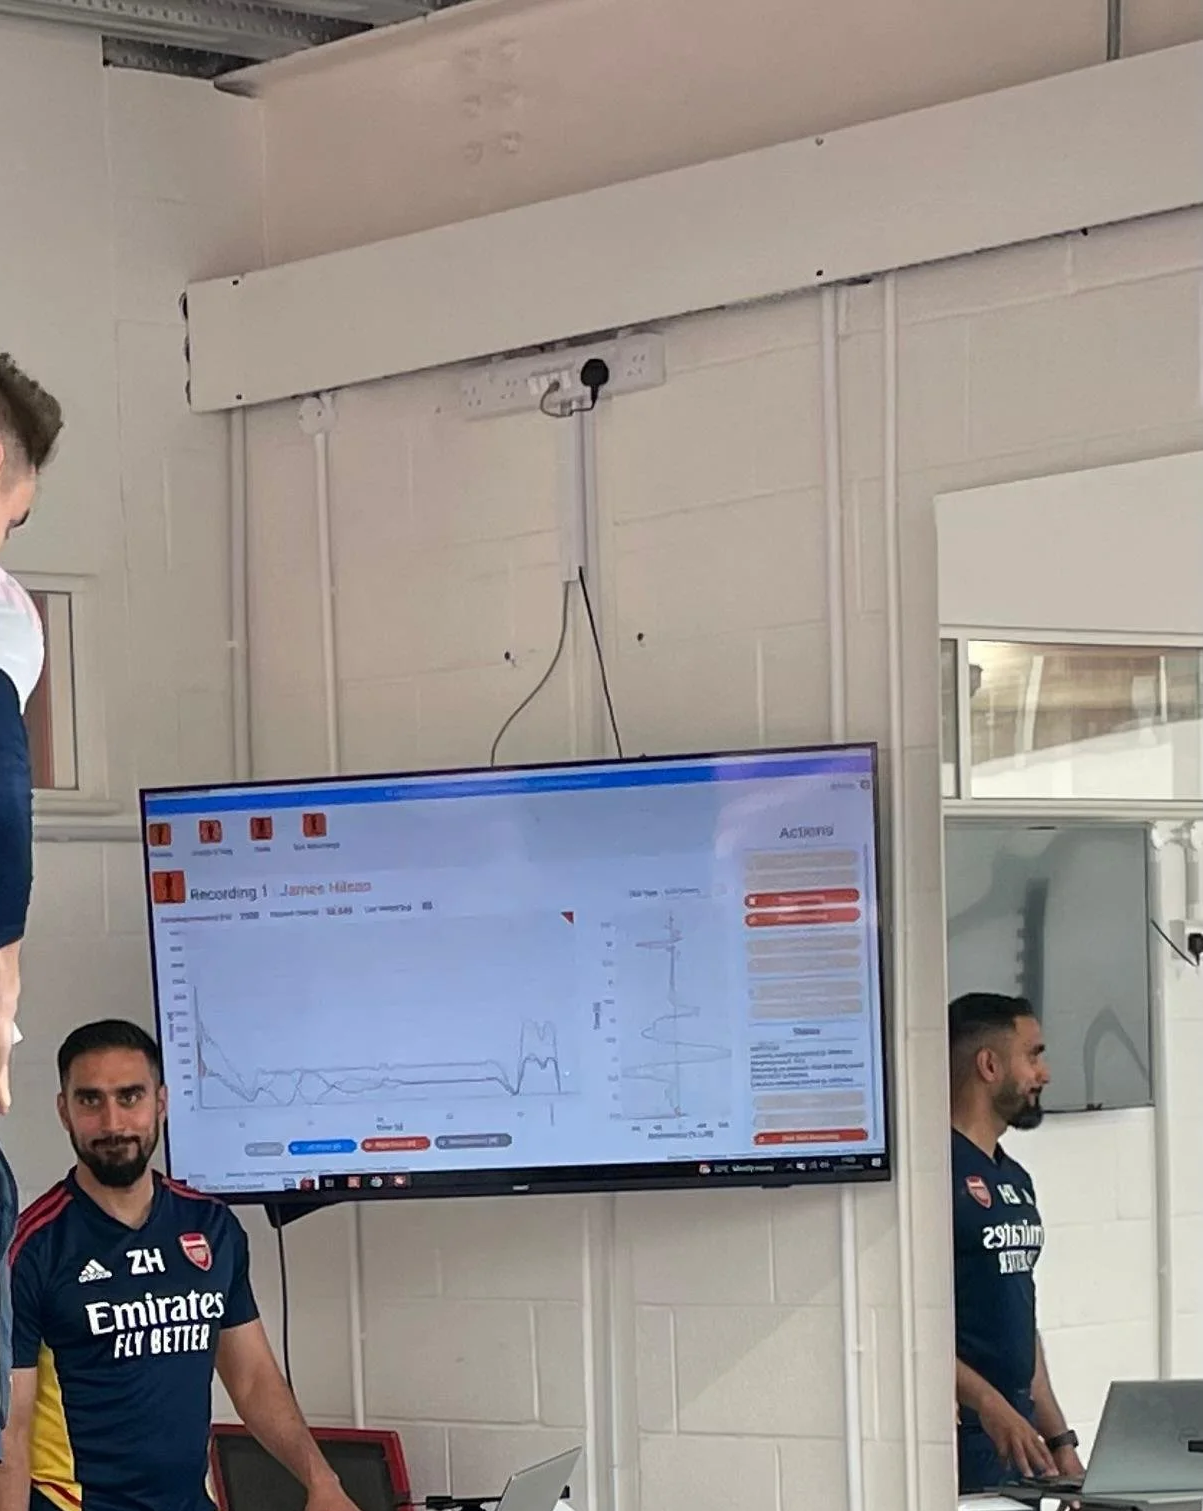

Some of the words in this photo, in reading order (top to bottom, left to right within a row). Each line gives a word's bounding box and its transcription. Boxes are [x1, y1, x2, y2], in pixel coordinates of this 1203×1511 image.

[190, 886, 258, 901] Recording
[126, 1248, 165, 1275] ZH
[85, 1289, 224, 1335] Emirates
[113, 1329, 149, 1359] FLY
[150, 1323, 211, 1355] BETTER
